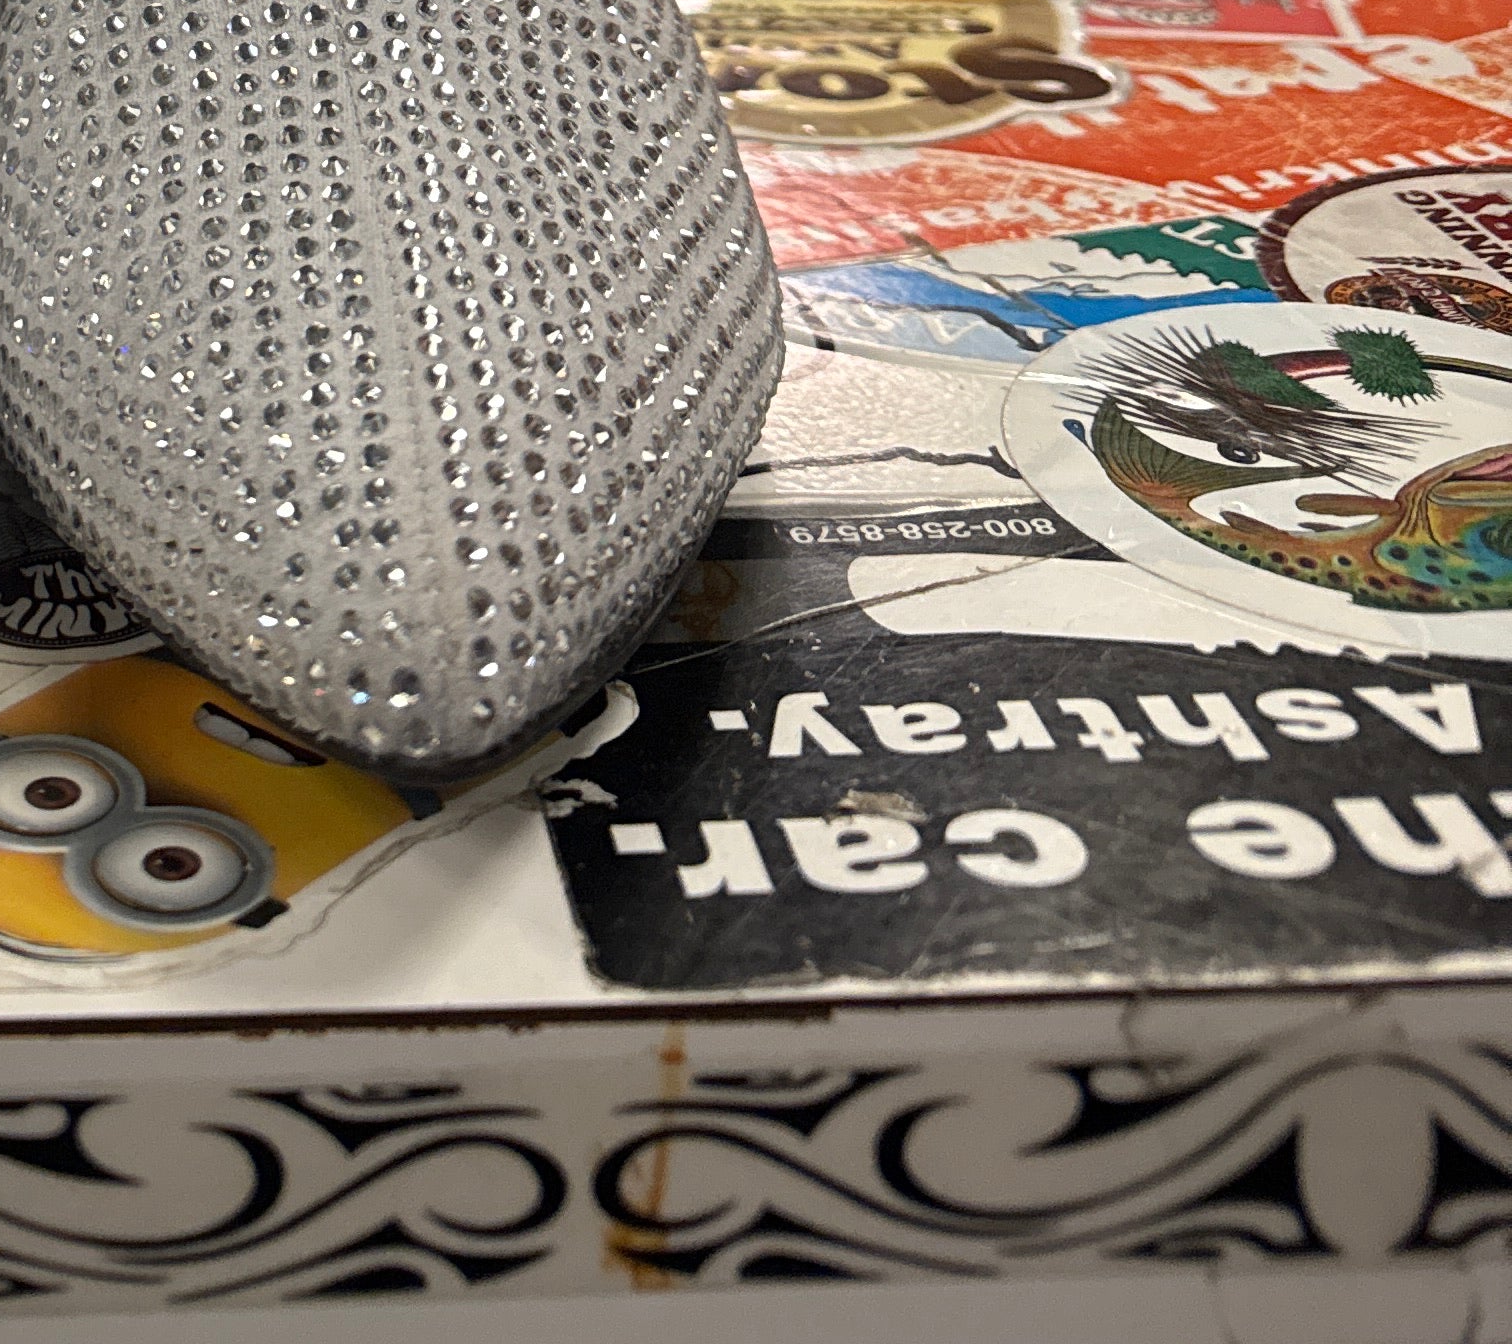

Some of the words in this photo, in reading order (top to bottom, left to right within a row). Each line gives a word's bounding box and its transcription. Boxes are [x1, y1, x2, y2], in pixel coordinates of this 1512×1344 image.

[1160, 218, 1258, 261] ST
[788, 517, 1058, 544] 800-258-8579
[708, 683, 1482, 763] Ashtray.
[610, 805, 1089, 899] car.
